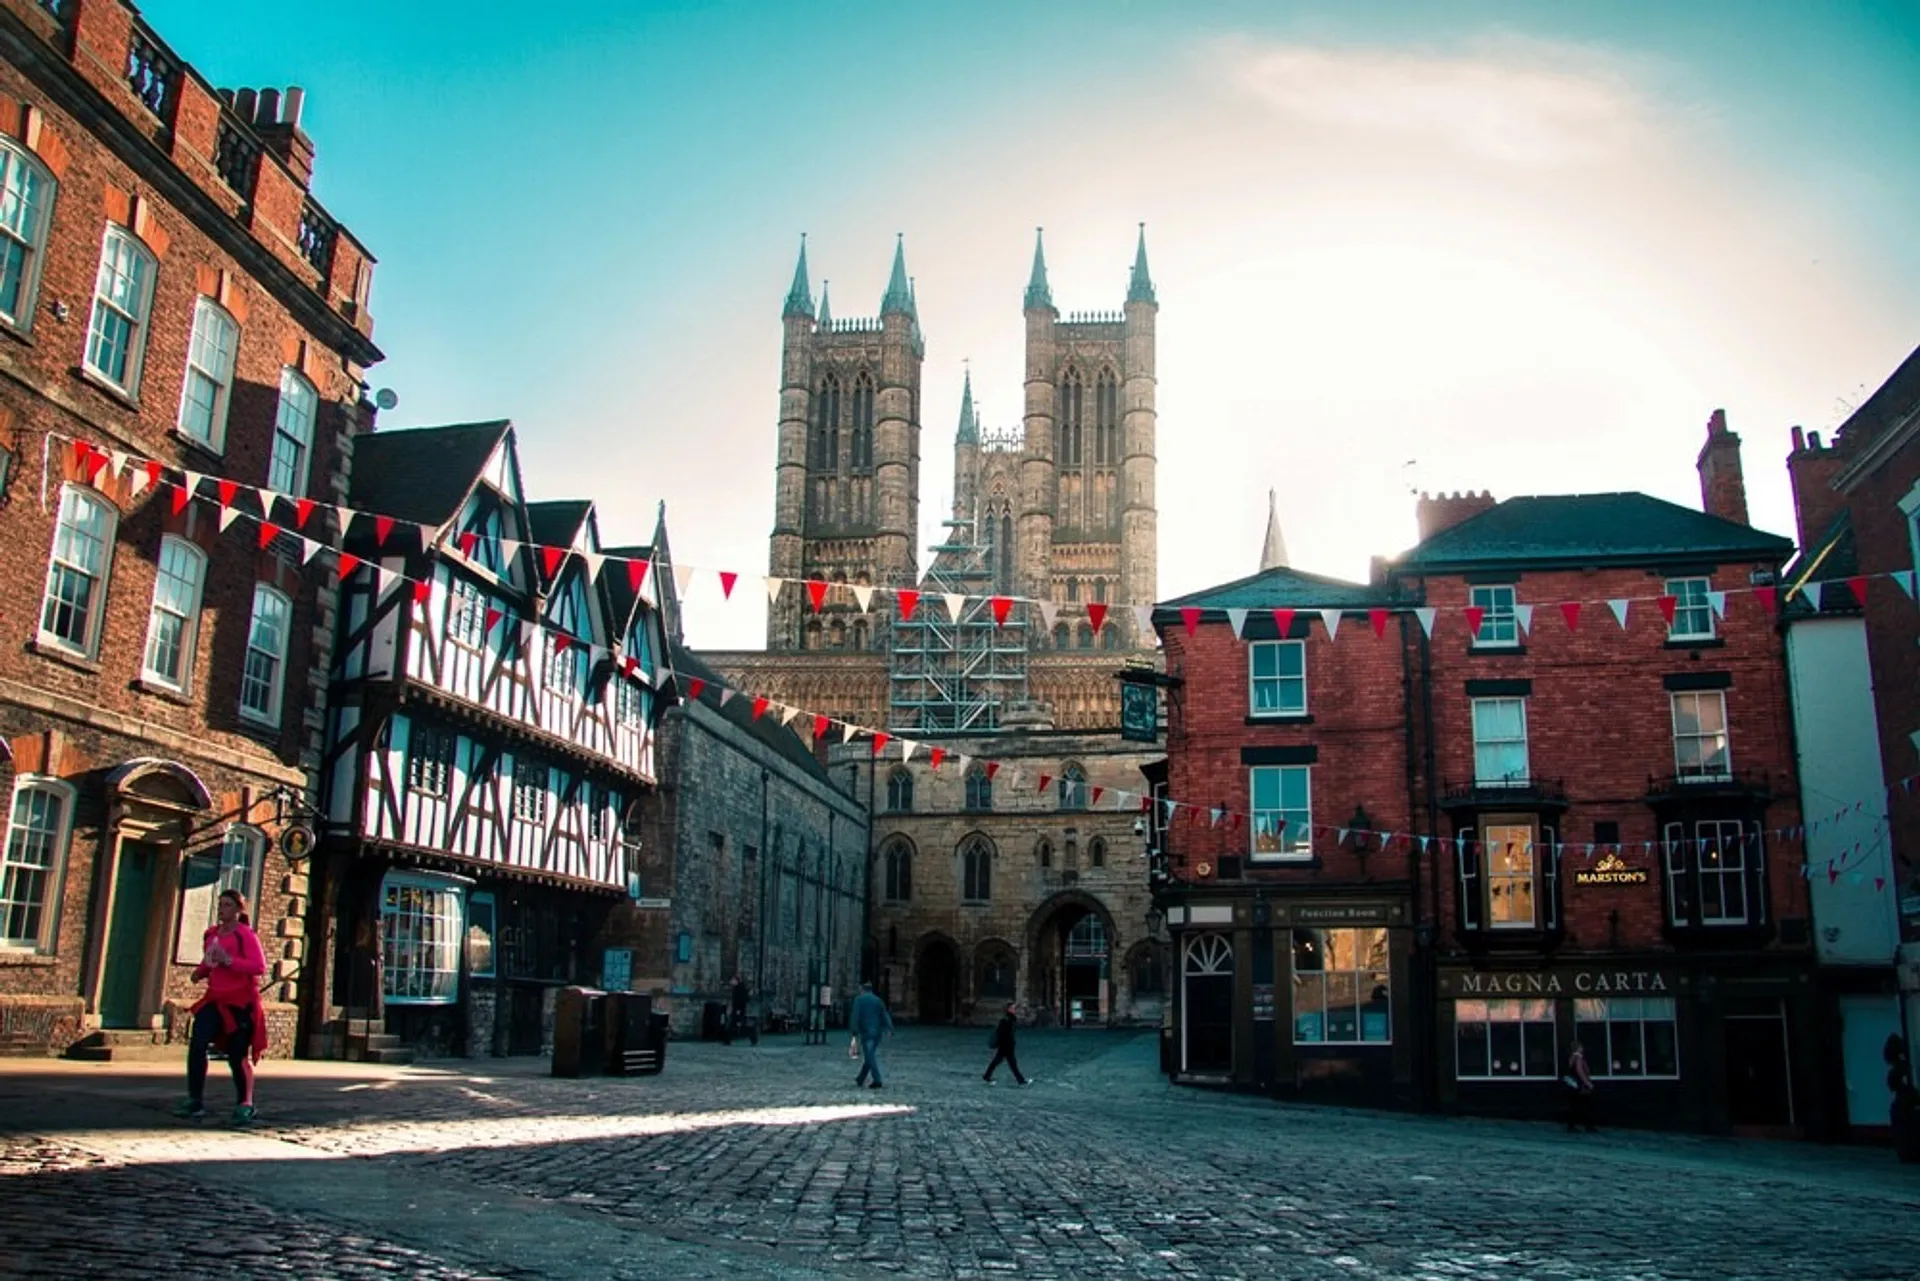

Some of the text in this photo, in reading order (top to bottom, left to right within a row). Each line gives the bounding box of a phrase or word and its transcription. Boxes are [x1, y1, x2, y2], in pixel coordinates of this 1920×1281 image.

[1577, 872, 1647, 883] MARSTON'S
[1462, 972, 1667, 992] MAGNA CARTA
